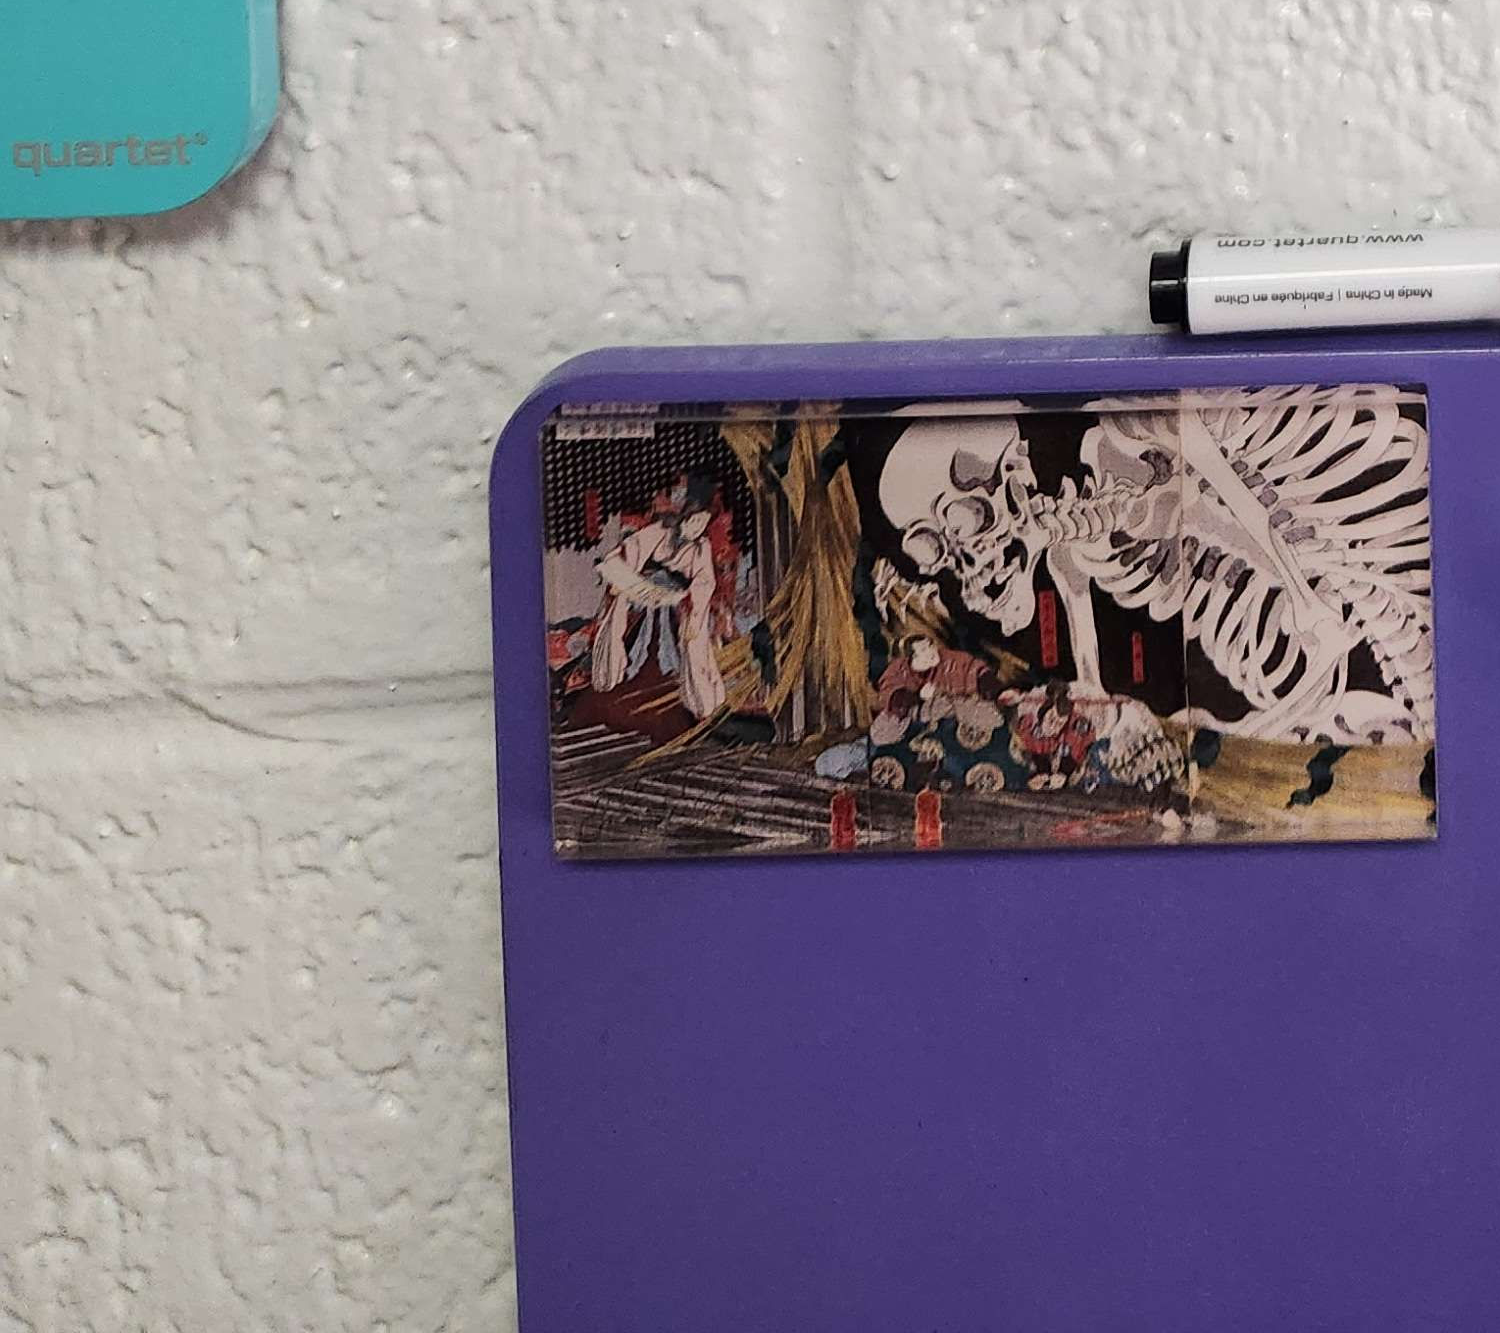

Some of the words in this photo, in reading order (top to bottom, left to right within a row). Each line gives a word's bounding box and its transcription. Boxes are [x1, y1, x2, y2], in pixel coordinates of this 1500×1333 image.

[1217, 233, 1424, 248] www.quartet.com
[1214, 292, 1250, 305] Chine
[1253, 293, 1269, 303] en
[1346, 288, 1381, 301] China
[1384, 288, 1395, 300] in
[1397, 286, 1433, 300] Made
